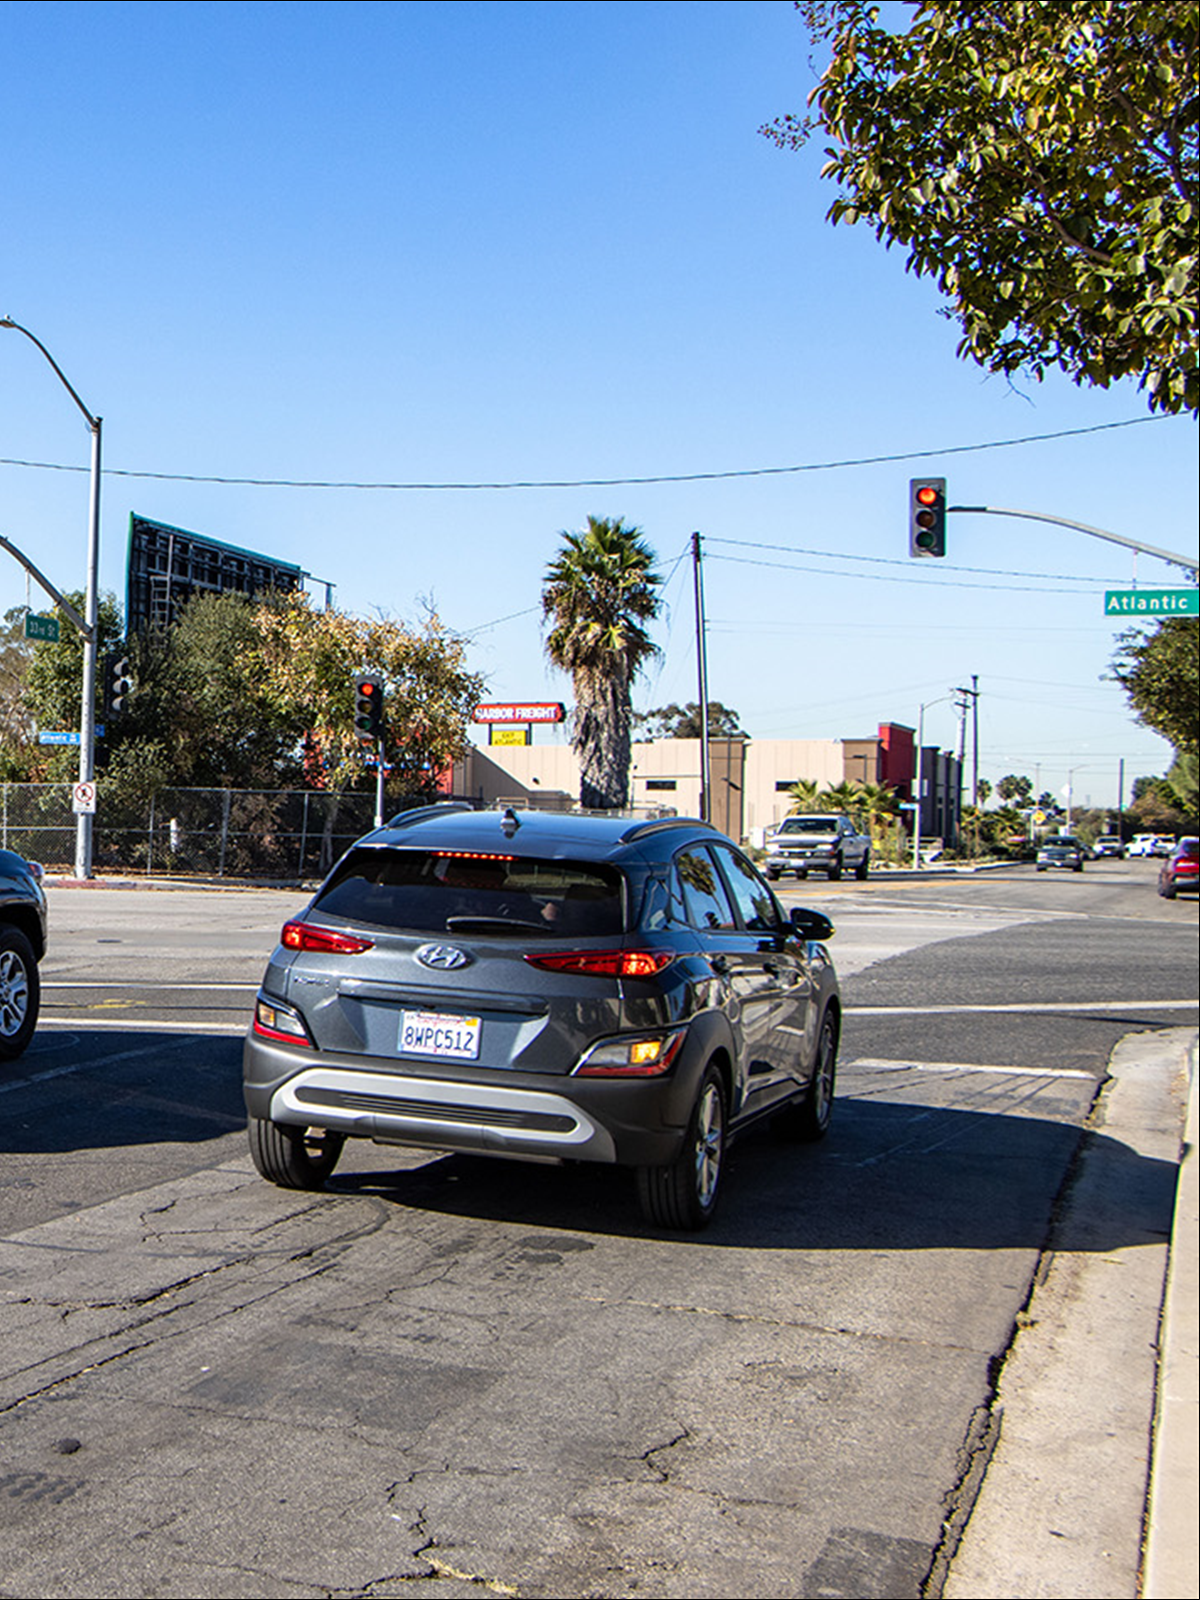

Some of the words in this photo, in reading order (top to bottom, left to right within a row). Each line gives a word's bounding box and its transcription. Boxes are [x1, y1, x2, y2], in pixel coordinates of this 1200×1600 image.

[1107, 595, 1188, 610] Atlantic
[515, 707, 557, 719] FREIGHT
[404, 1025, 475, 1052] 8WPC512
